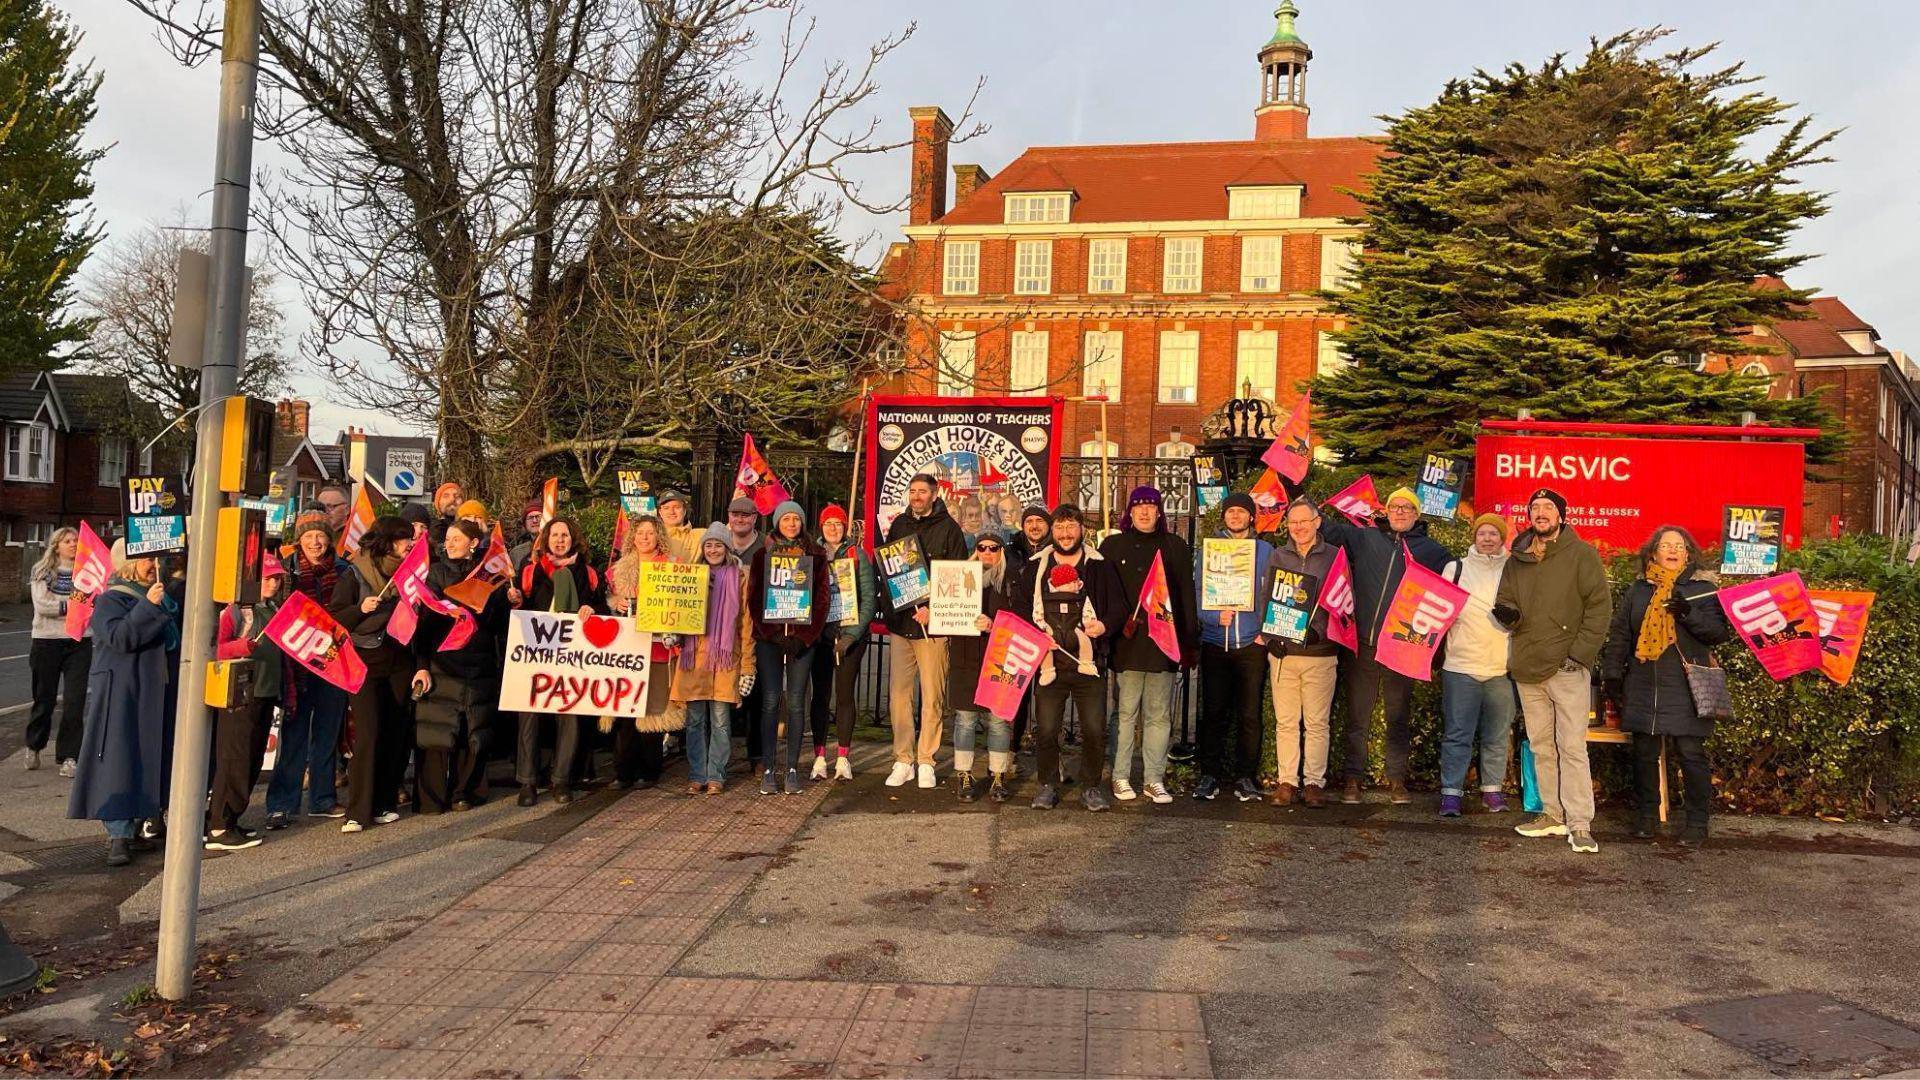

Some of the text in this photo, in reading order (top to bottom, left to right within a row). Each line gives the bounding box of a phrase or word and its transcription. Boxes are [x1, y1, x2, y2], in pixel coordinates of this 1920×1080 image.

[878, 412, 1051, 425] NATIONAL UNION OF TEACHERS
[881, 427, 1041, 506] BRIGHTON HOVE & SUSSE
[1195, 457, 1214, 468] PAY
[1427, 454, 1454, 471] PAY
[1496, 454, 1631, 481] BHASVIC
[618, 471, 641, 481] PAY
[892, 474, 912, 506] SIXTH
[911, 446, 943, 471] FORM
[950, 442, 997, 460] COLLEGE
[1196, 468, 1211, 484] UP
[1423, 466, 1445, 484] UP
[129, 478, 164, 493] PAY
[619, 480, 637, 494] UP
[129, 492, 157, 513] UP
[1566, 506, 1640, 517] OVE & SUSSEX
[1729, 508, 1767, 522] PAY
[135, 516, 175, 527] SIXTH FORM
[1565, 517, 1609, 526] COLLEGE
[1729, 520, 1756, 540] UP
[129, 539, 180, 553] PAY JUSTICE
[880, 541, 905, 559] PAY
[652, 563, 700, 574] WE DON'T
[771, 557, 800, 570] PAY
[881, 556, 904, 576] UP
[647, 574, 697, 584] FORGET OUR
[770, 568, 791, 586] UP
[1275, 569, 1303, 588] PAY
[655, 585, 698, 595] STUDENTS
[937, 584, 960, 598] ME
[1272, 582, 1294, 603] UP
[1326, 575, 1354, 615] UP
[646, 598, 704, 609] DON'T FORGET
[661, 611, 680, 627] US!
[765, 610, 778, 618] PAY
[1731, 590, 1788, 636] UP
[530, 617, 575, 644] WE
[281, 619, 333, 660] UP
[511, 645, 645, 672] SIXTH FORM COLLEGES
[529, 673, 590, 713] PAY
